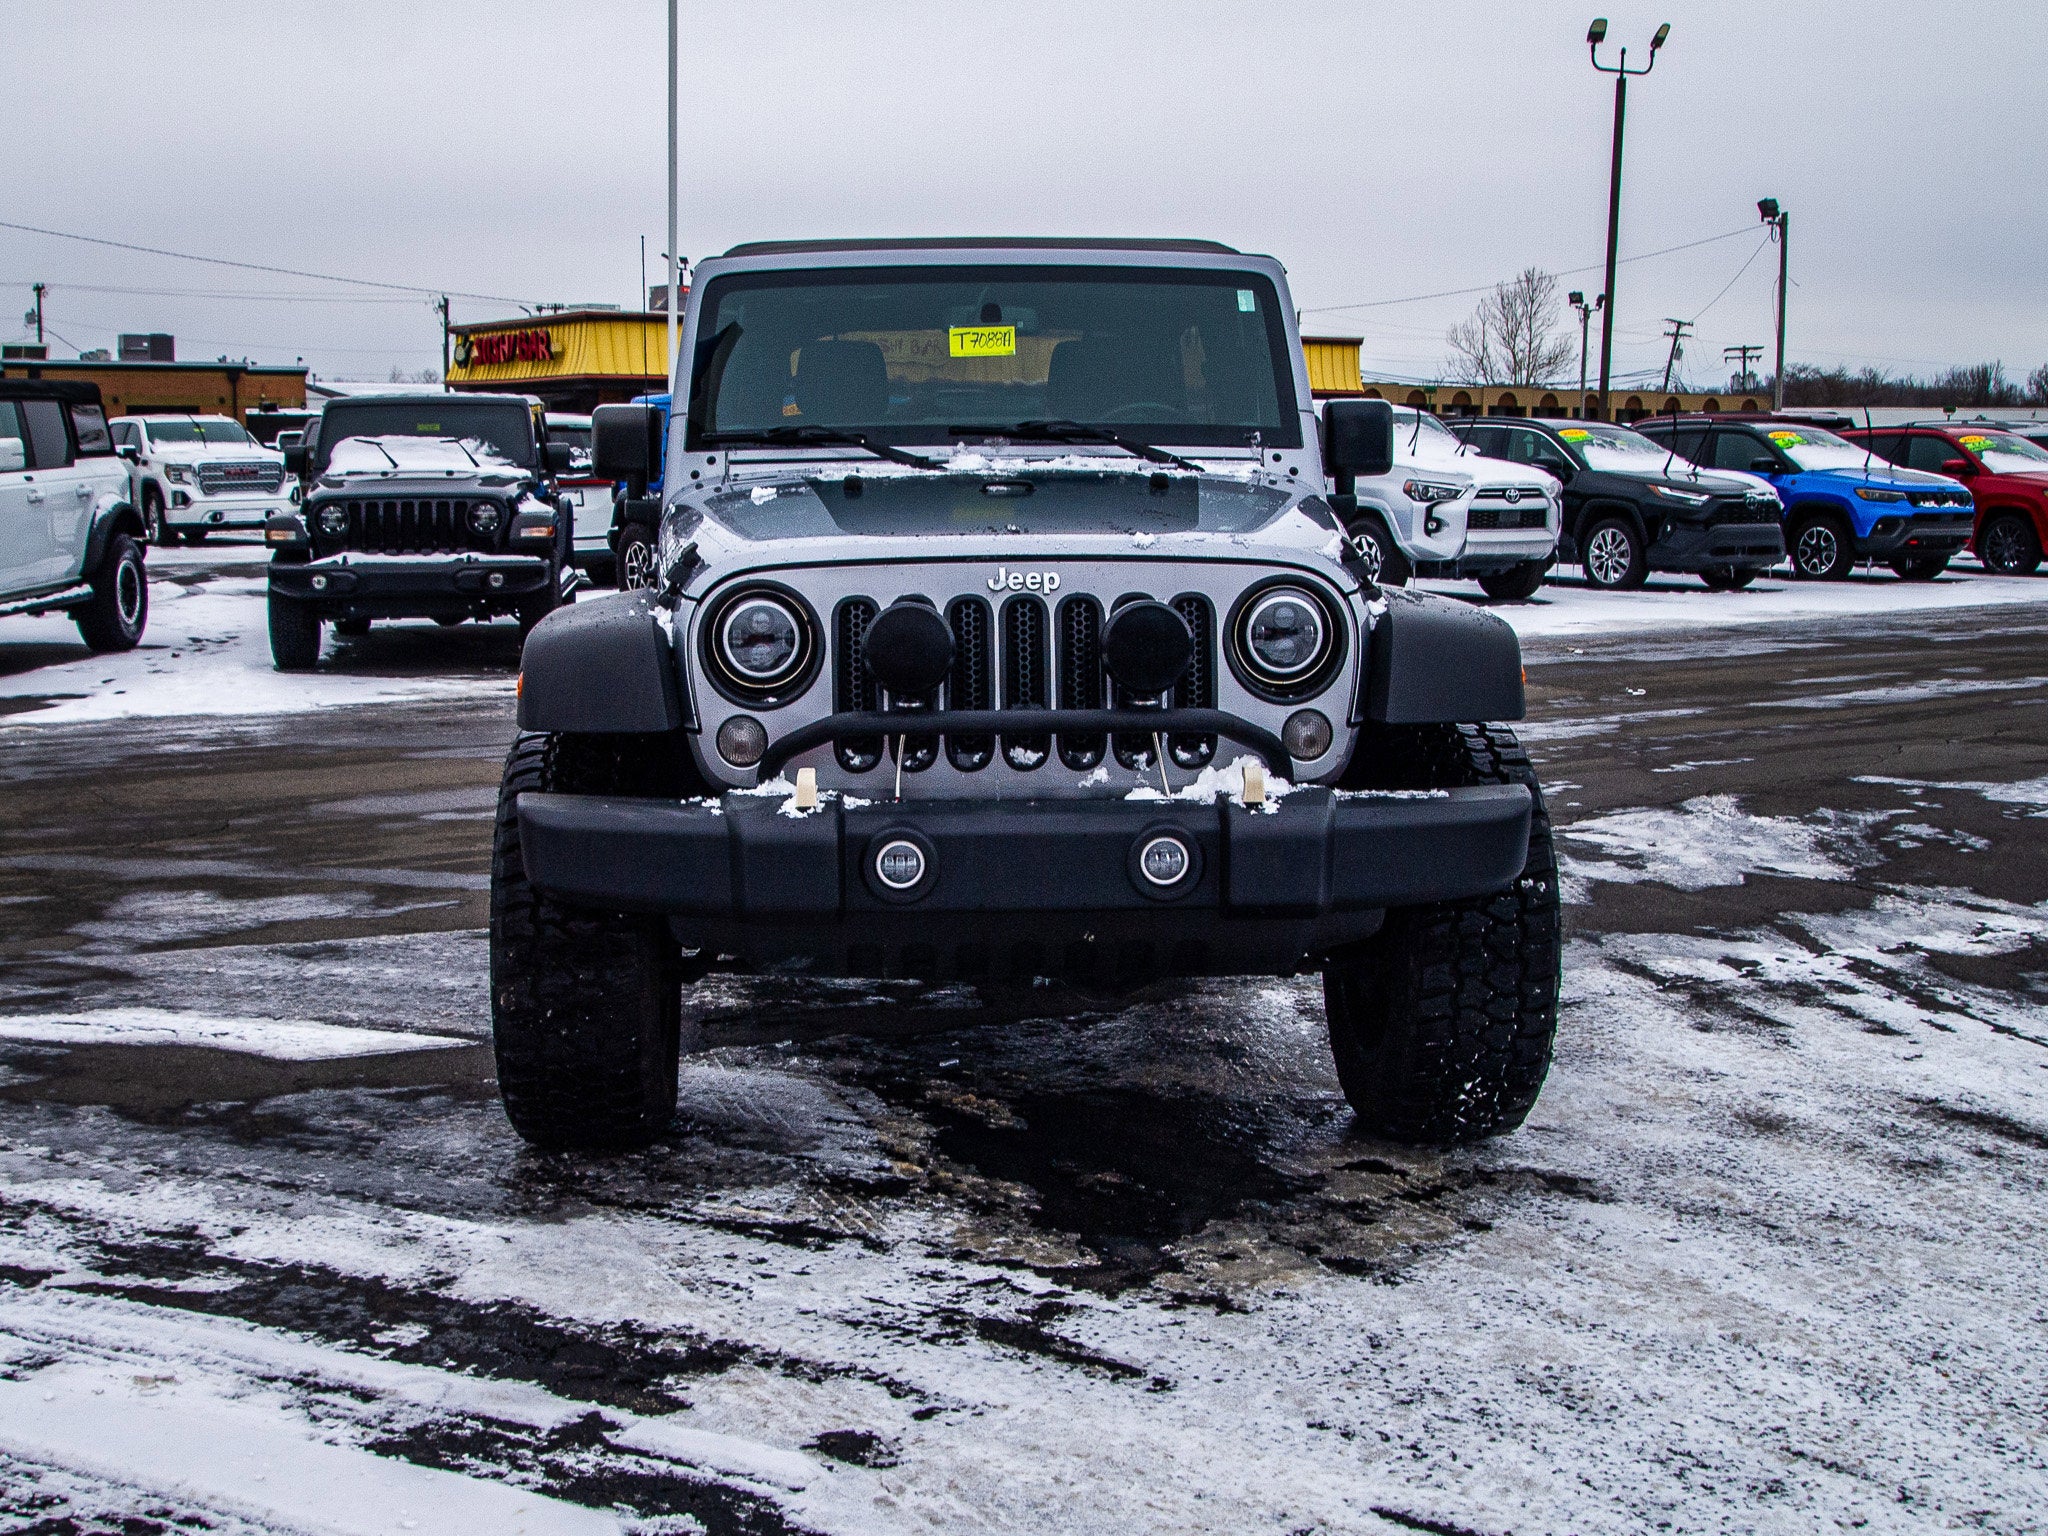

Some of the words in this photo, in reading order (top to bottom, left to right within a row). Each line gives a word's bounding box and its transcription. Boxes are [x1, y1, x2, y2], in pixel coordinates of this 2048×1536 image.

[473, 335, 515, 366] SUSHI
[518, 329, 550, 361] BAR
[987, 566, 1061, 595] Jeep
